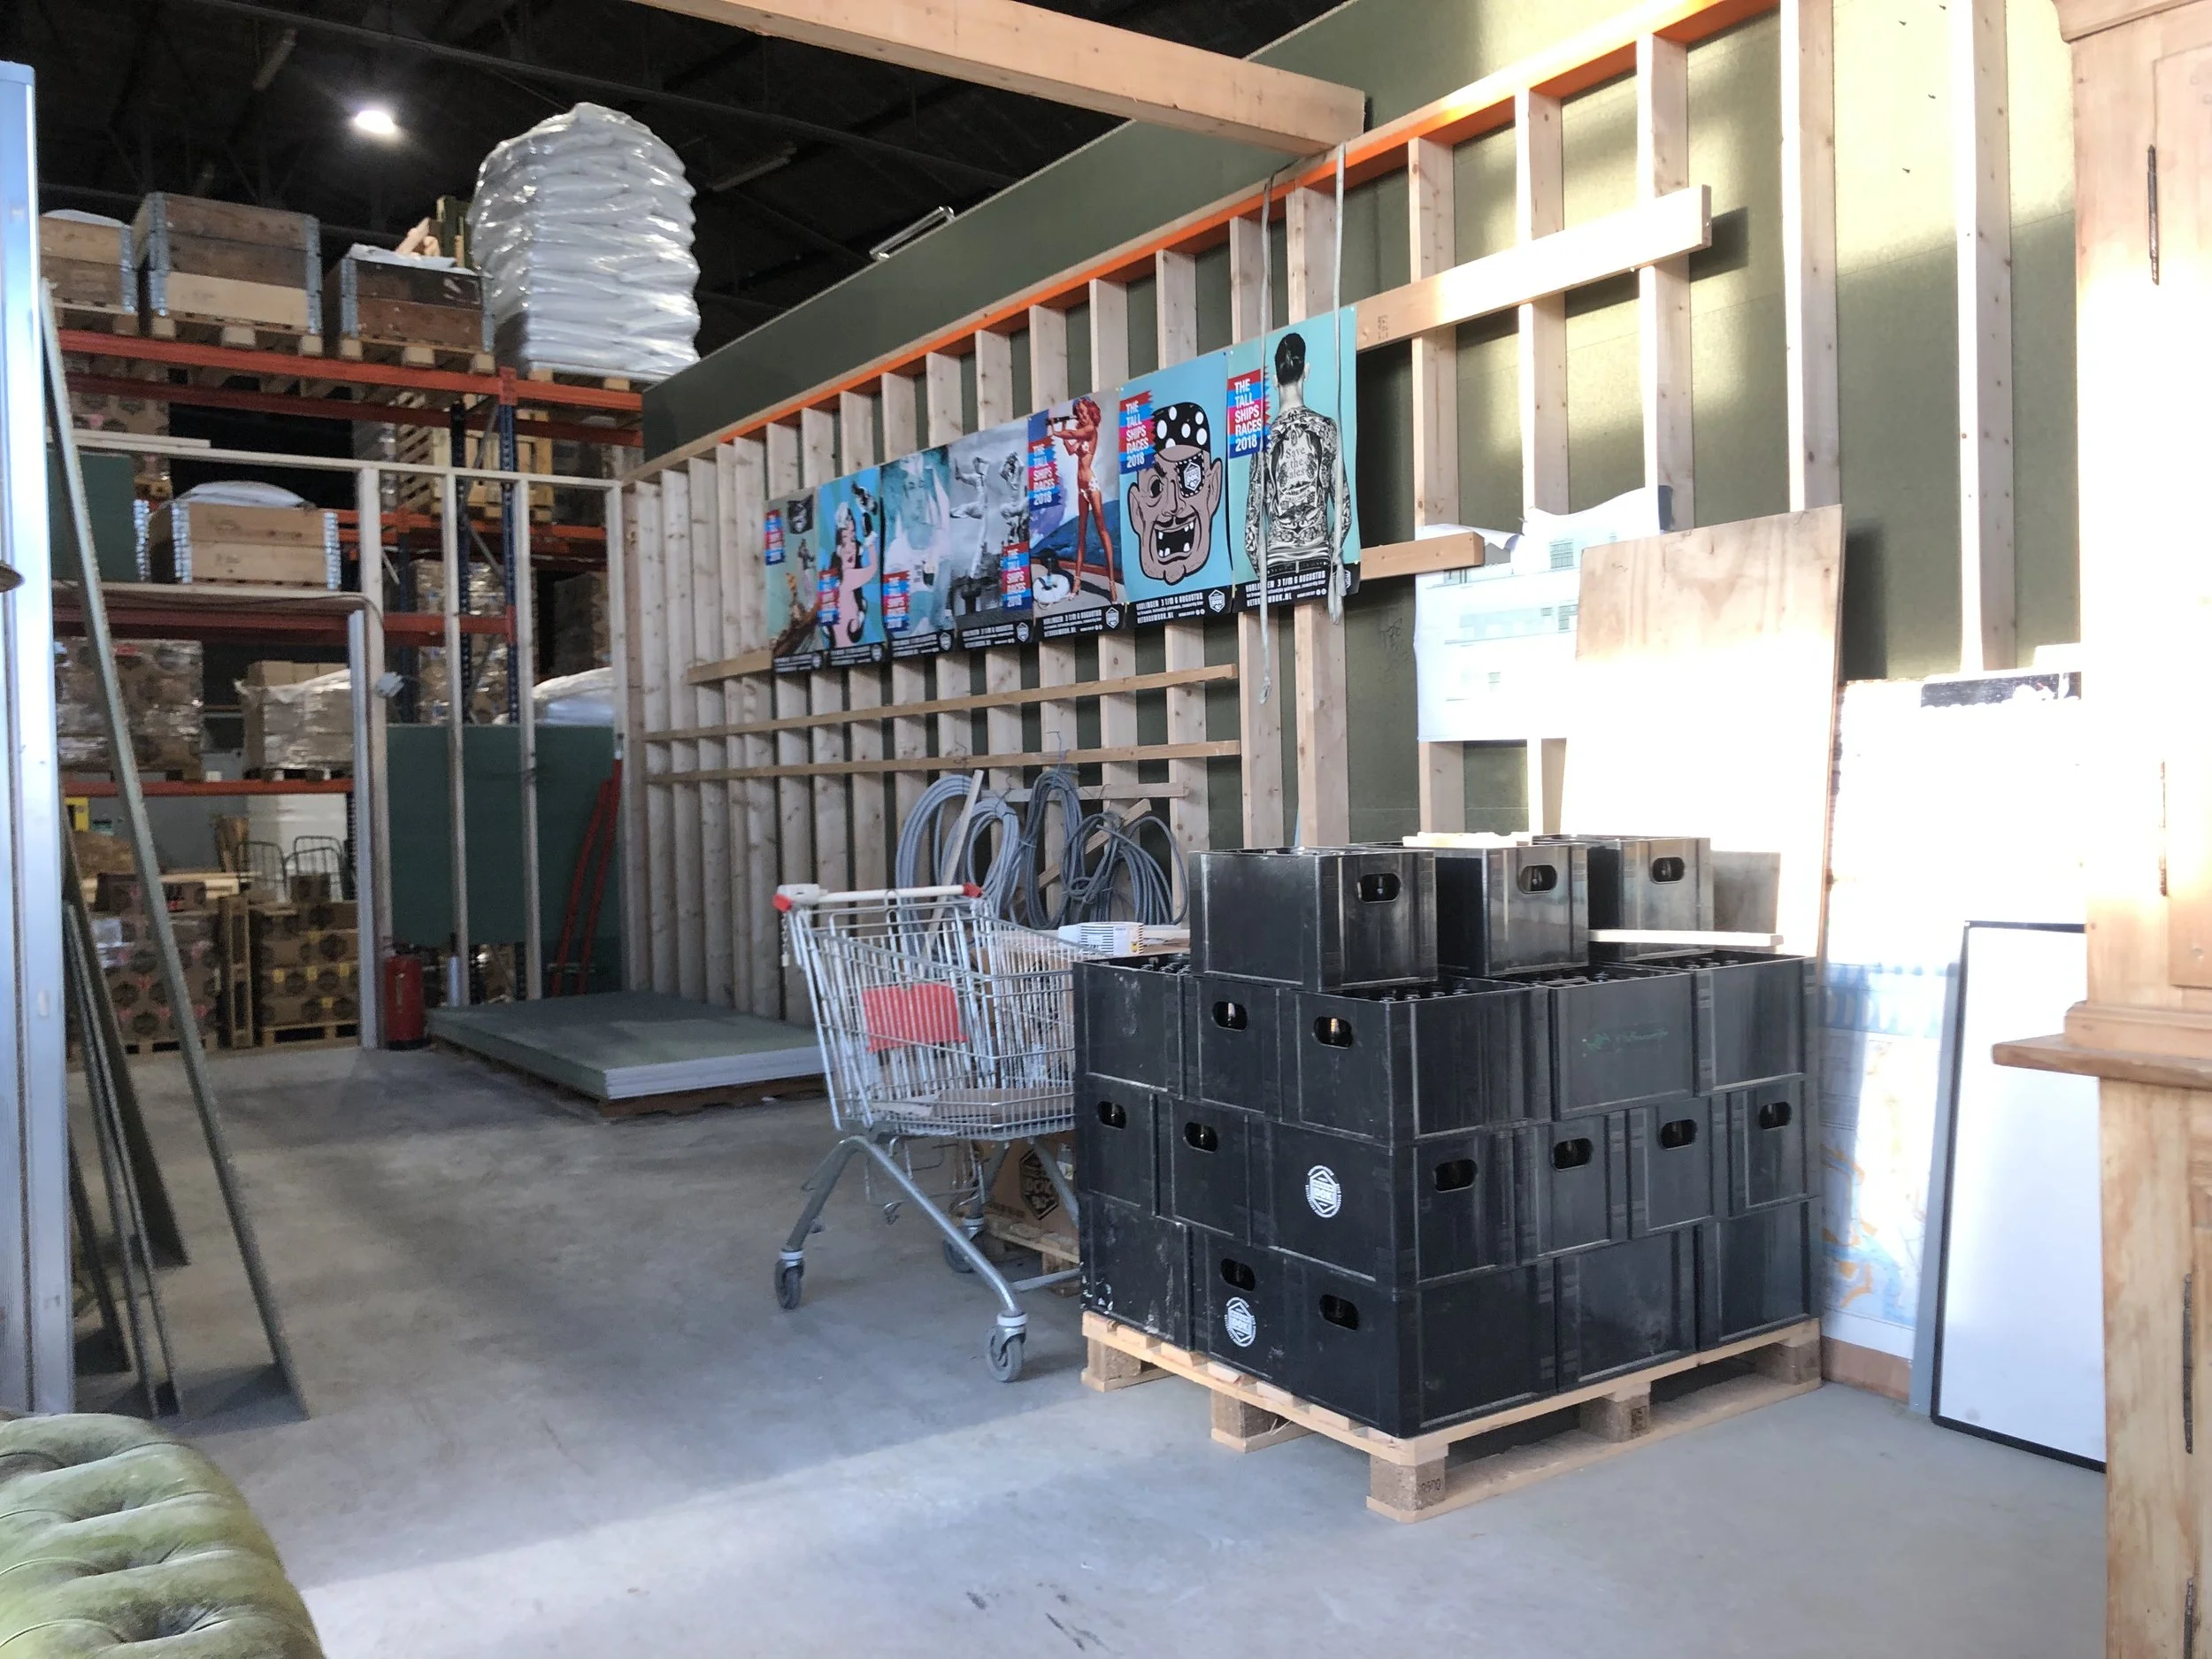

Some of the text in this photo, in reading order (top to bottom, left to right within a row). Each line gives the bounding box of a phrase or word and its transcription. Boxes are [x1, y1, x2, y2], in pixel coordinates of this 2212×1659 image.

[1234, 379, 1250, 395] THE
[1125, 400, 1139, 415] THE
[1235, 392, 1255, 409] TALL
[1125, 413, 1142, 428] TALL
[1235, 404, 1259, 423] SHIPS
[1125, 425, 1147, 442] SHIPS
[1235, 419, 1262, 437] RACES
[1126, 437, 1149, 454] RACES
[1235, 434, 1257, 452] 2018
[1126, 452, 1145, 468] 2018
[1299, 571, 1325, 583] AUGUSTUS
